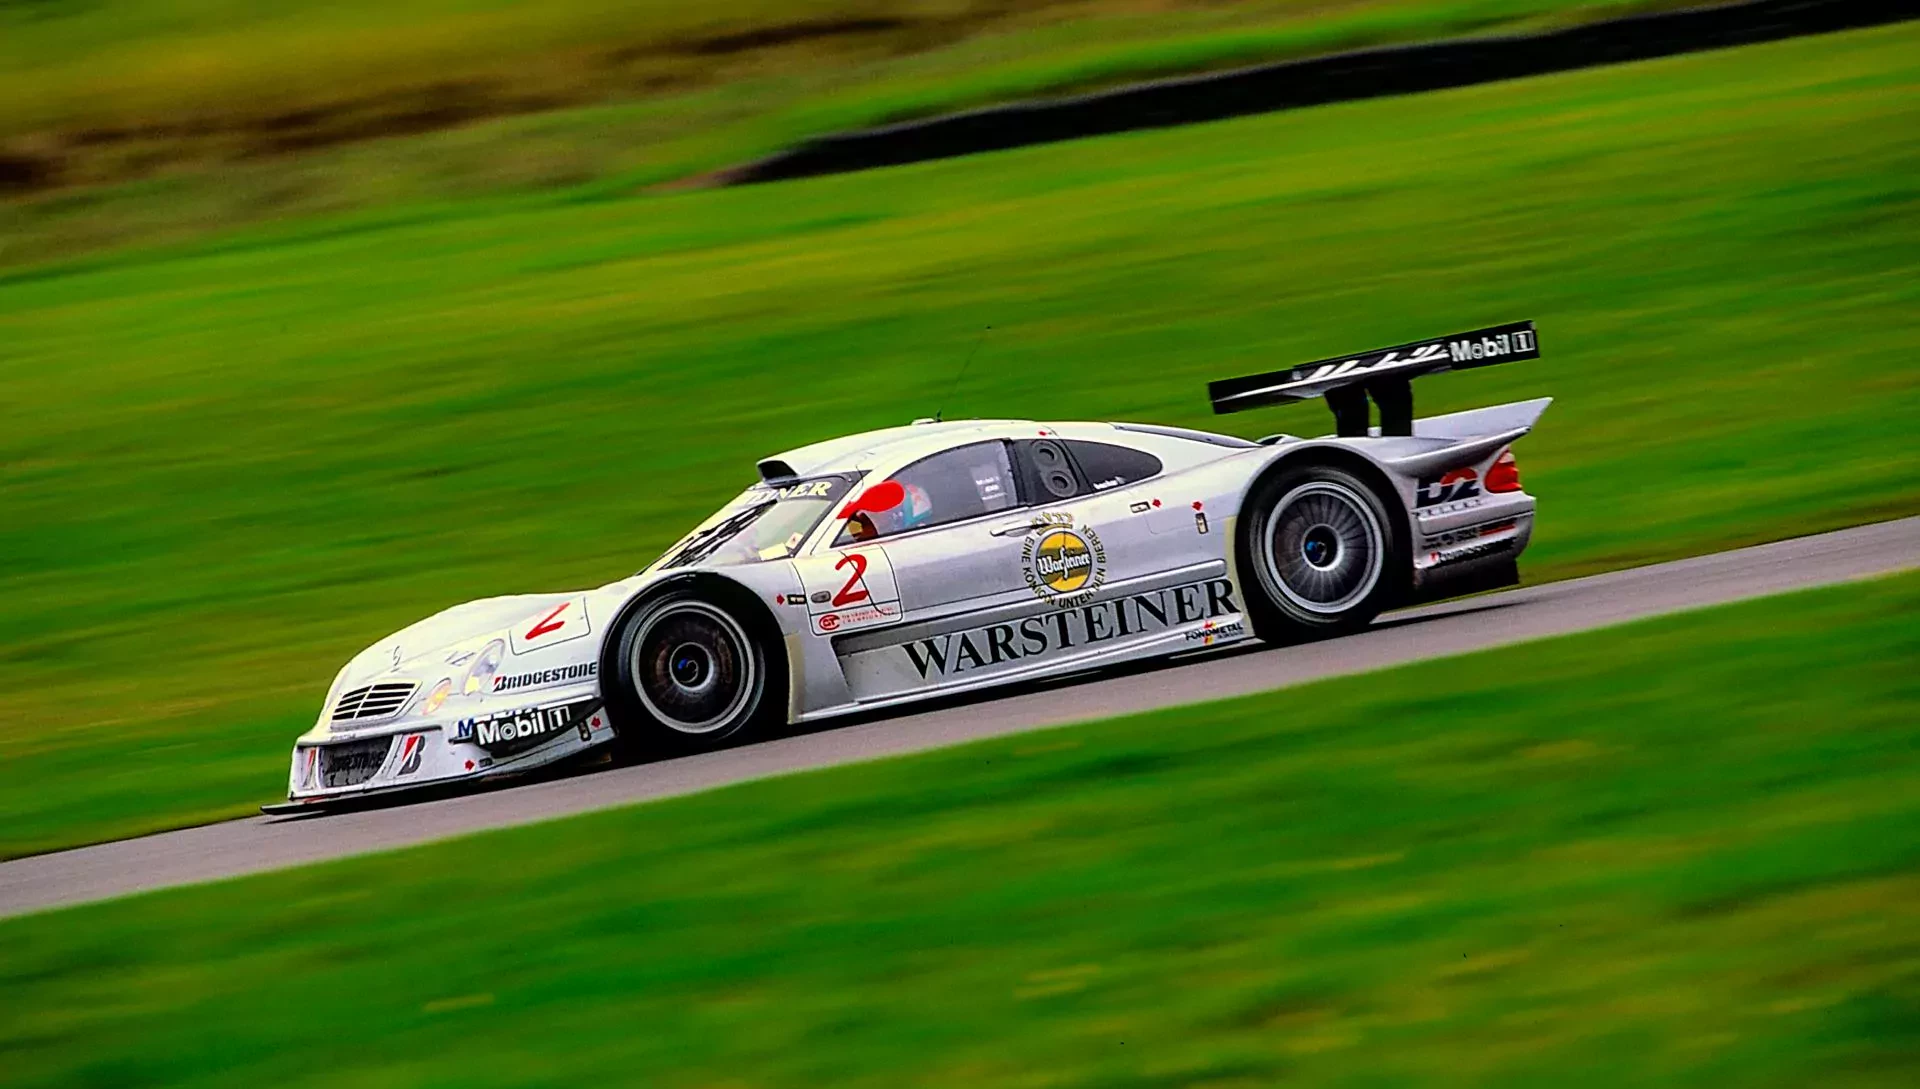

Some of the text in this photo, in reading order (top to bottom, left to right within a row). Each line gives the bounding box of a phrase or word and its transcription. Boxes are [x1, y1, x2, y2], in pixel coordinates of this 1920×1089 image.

[1449, 333, 1511, 362] Mobil
[1416, 467, 1480, 508] D2
[832, 553, 869, 607] 2
[1022, 536, 1035, 563] EINE
[1059, 590, 1094, 608] UNTER
[1081, 524, 1106, 563] BIEREN
[902, 579, 1242, 681] WARSTEINER
[493, 661, 598, 693] BRIDGESTONE
[476, 711, 546, 746] Mobil
